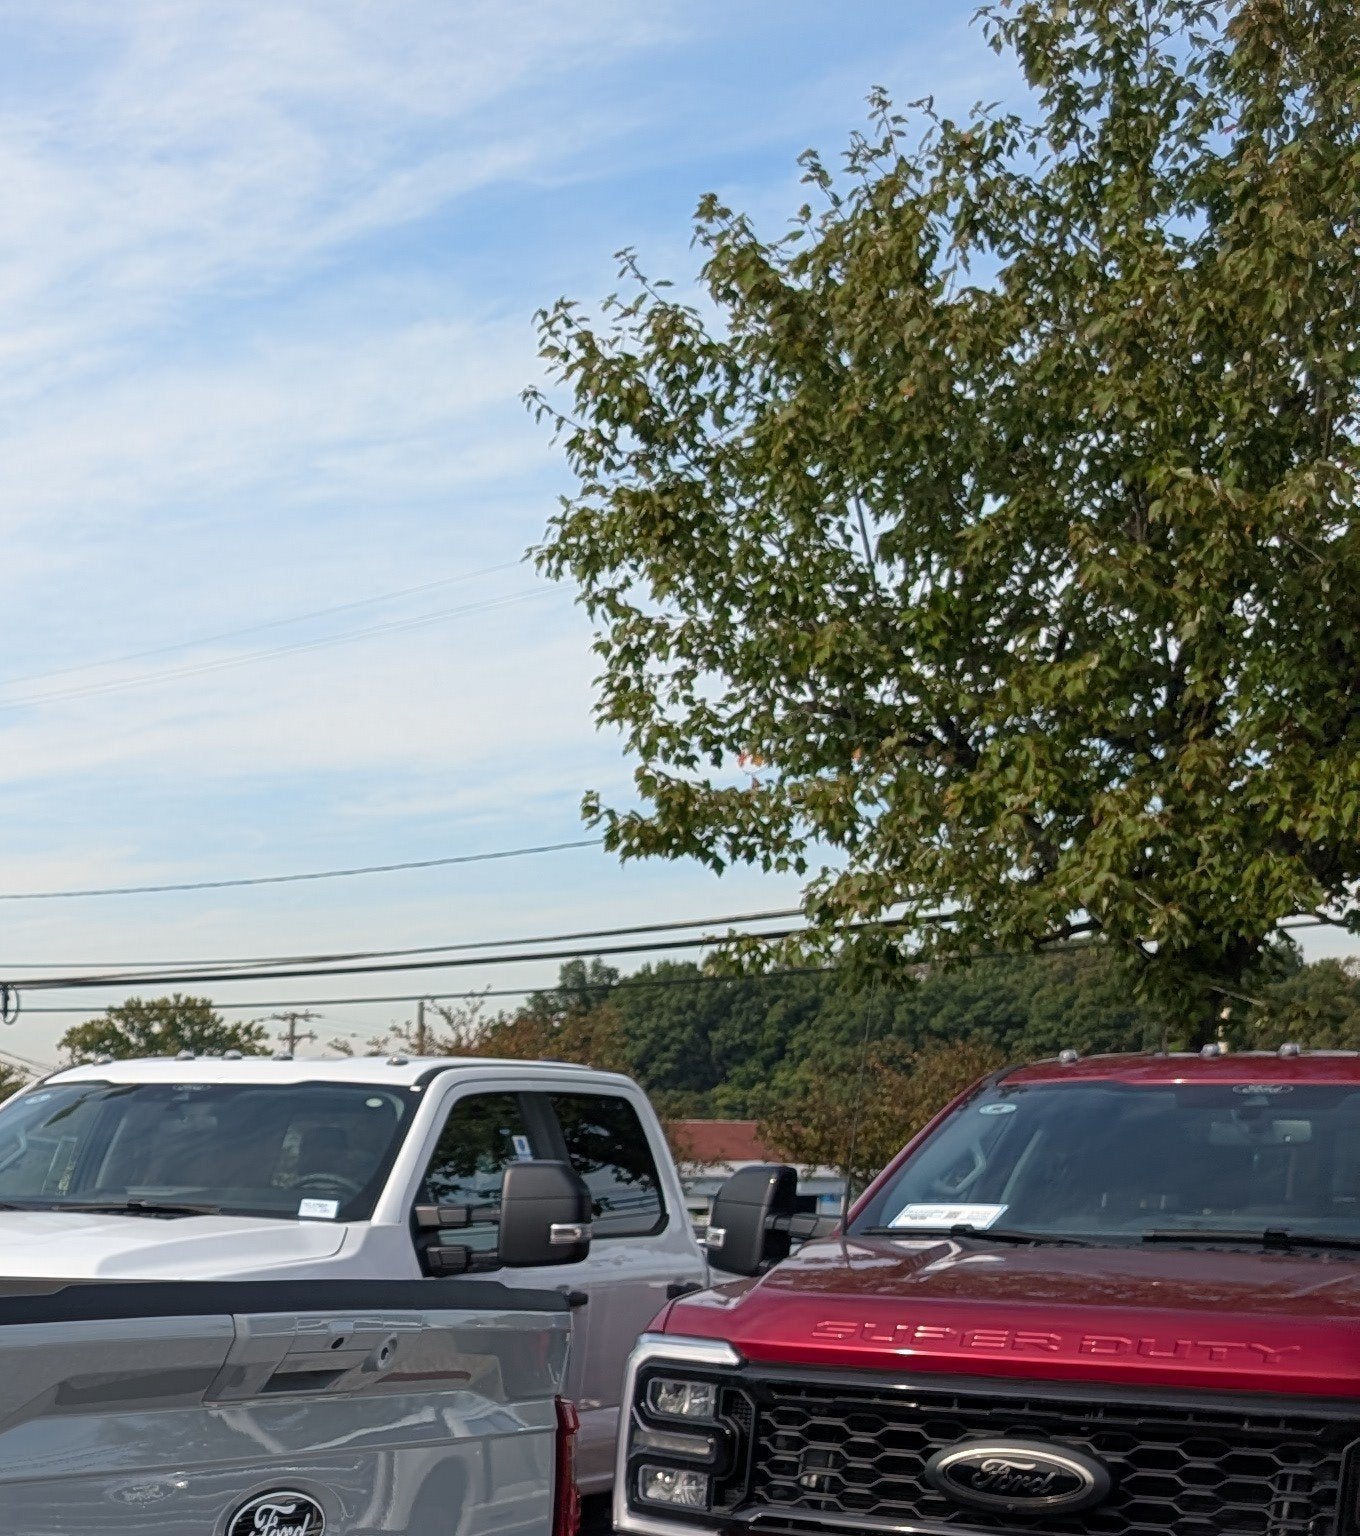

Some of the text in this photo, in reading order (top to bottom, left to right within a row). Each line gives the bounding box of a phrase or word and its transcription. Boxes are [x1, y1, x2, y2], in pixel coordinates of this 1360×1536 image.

[812, 1319, 1302, 1364] SUPER DUTY
[971, 1458, 1057, 1494] Ford
